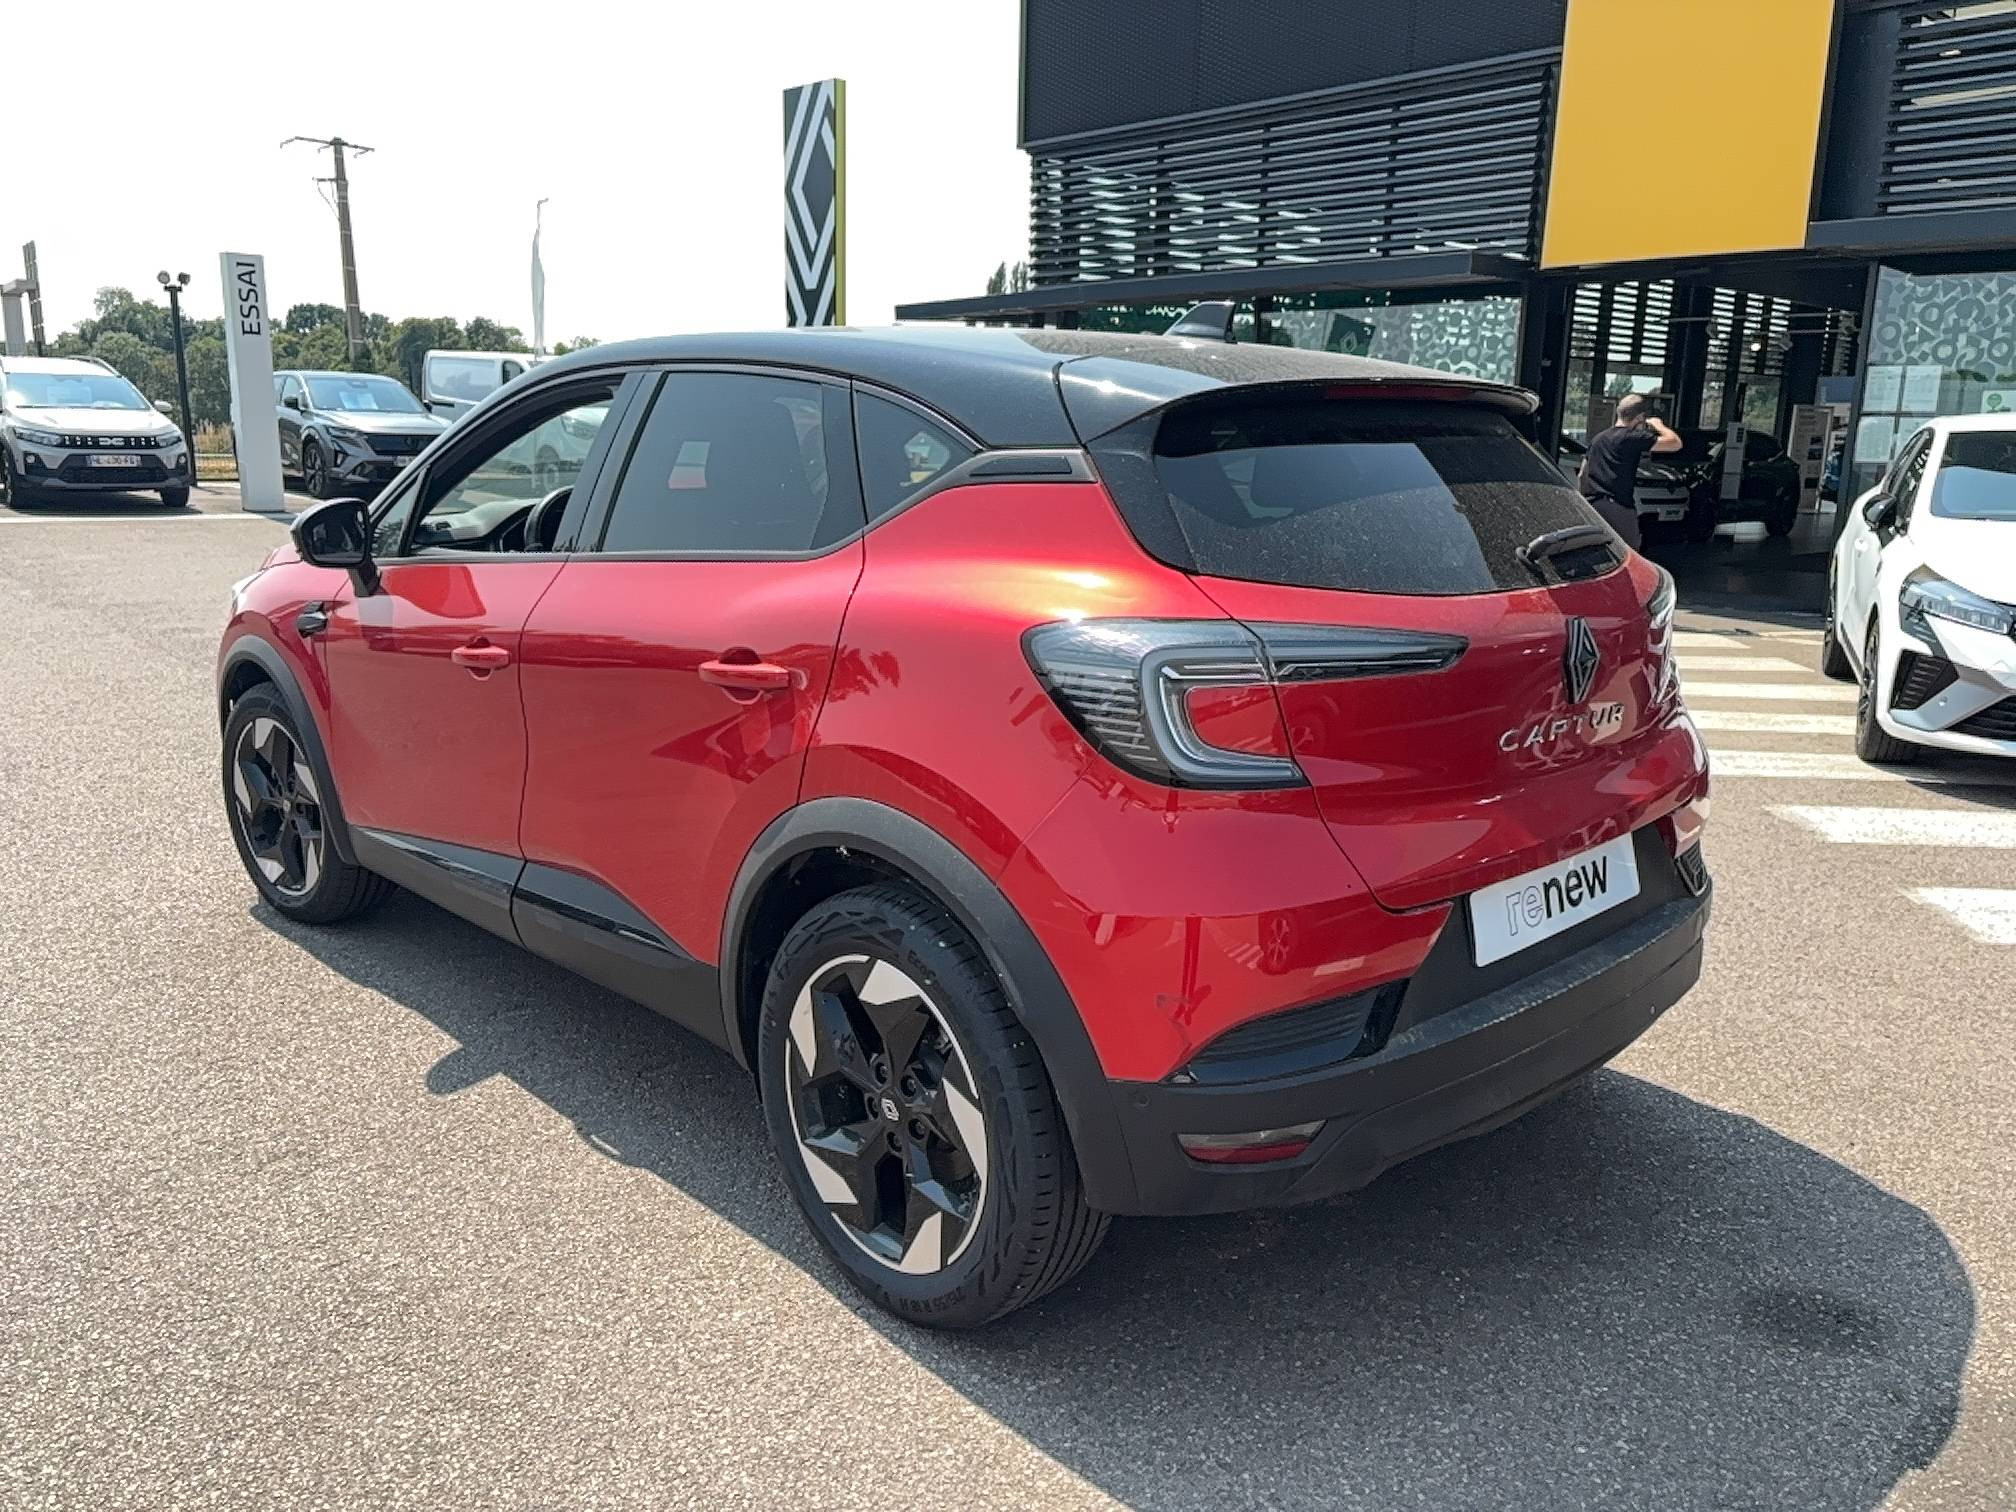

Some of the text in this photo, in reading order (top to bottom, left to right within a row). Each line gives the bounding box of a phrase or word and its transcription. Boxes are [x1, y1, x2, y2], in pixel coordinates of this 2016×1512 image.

[236, 261, 261, 336] ESSAI
[1499, 703, 1625, 752] CAPTUR
[1505, 855, 1608, 937] renew
